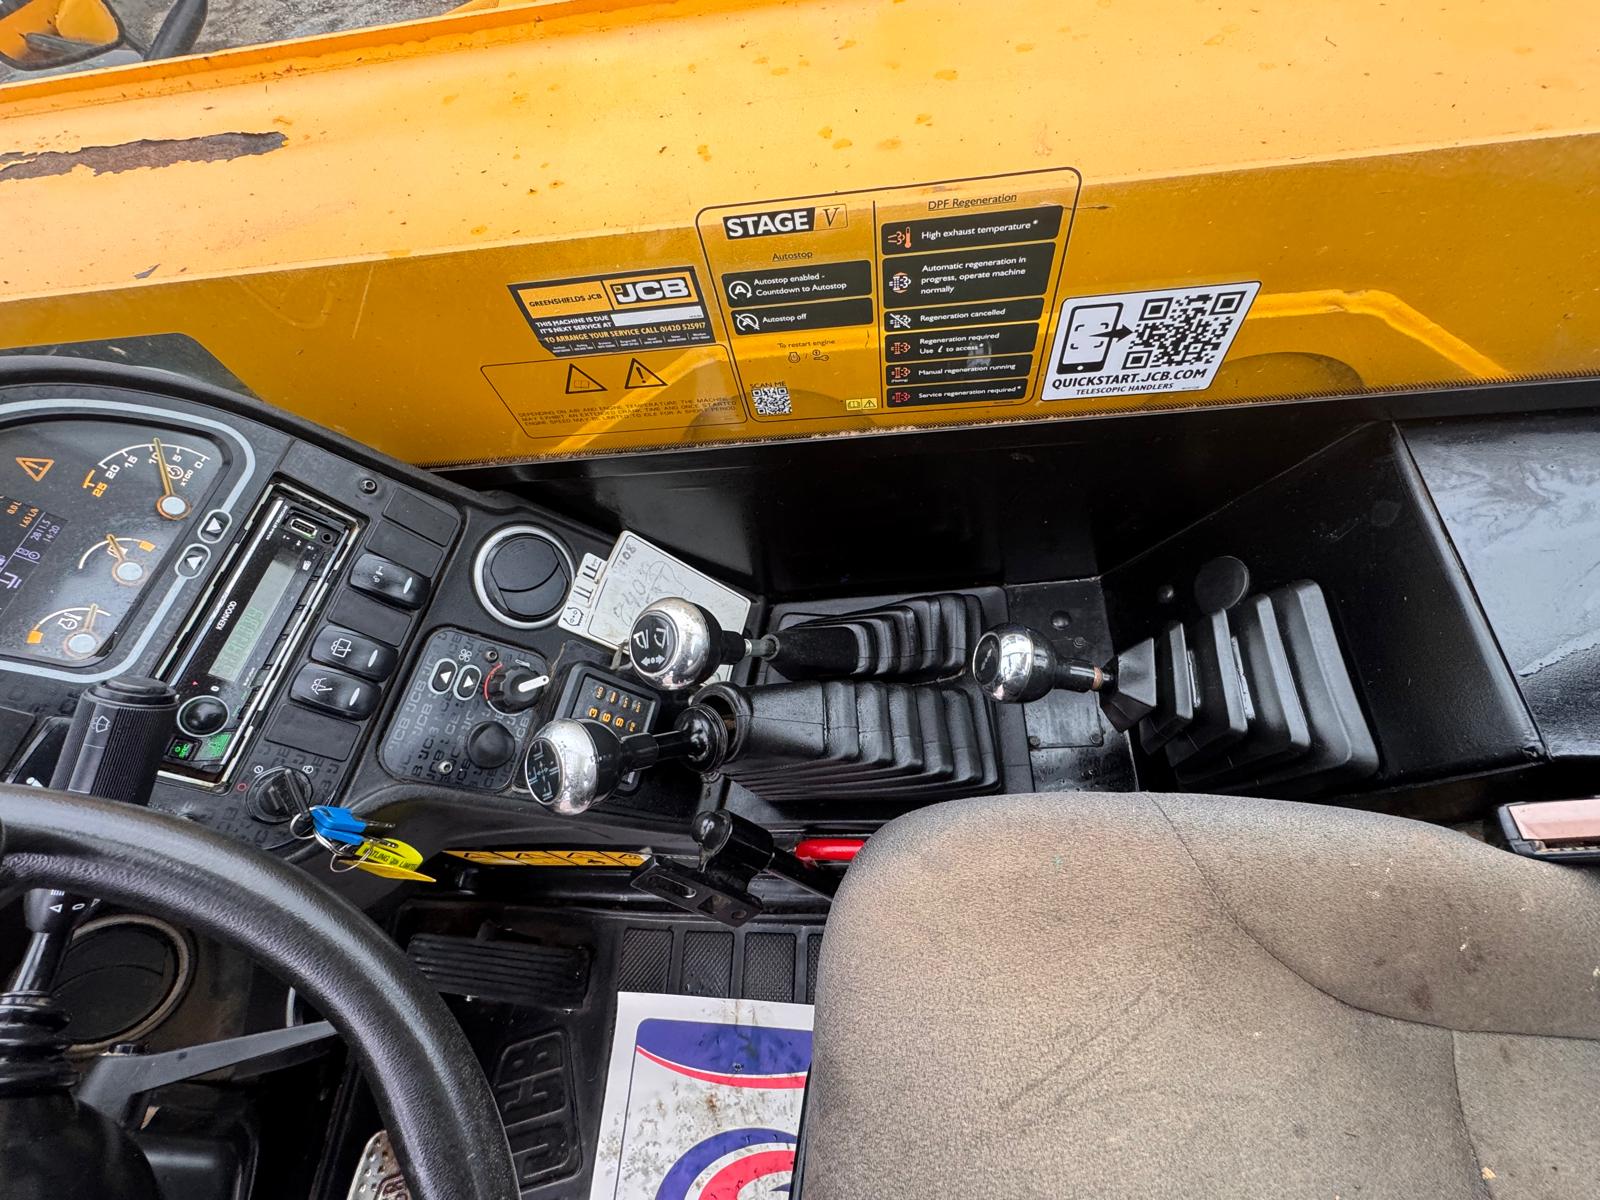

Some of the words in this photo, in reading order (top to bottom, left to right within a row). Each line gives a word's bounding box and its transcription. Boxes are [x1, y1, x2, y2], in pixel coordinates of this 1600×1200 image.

[928, 199, 949, 210] DPF
[952, 193, 1017, 208] Regeneration
[726, 210, 809, 238] STAGE
[823, 207, 840, 227] V
[921, 231, 941, 241] High
[943, 227, 975, 238] exhaust
[977, 221, 1031, 235] temperature
[772, 250, 813, 262] Autostop
[921, 262, 964, 273] Automatic
[965, 256, 1016, 270] regeneration
[1018, 256, 1026, 264] in
[754, 275, 788, 287] Autostop
[790, 273, 819, 283] enabled
[921, 275, 957, 286] progress,
[959, 271, 991, 282] operate
[992, 267, 1026, 277] machine
[615, 278, 690, 304] JCB
[756, 286, 800, 297] Countdown
[802, 285, 810, 293] to
[812, 282, 847, 293] Autostop
[921, 285, 955, 296] normally
[529, 295, 585, 308] GREENSHIELDS
[587, 293, 602, 301] JCB
[535, 320, 552, 328] THIS
[553, 317, 585, 327] MACHINE
[586, 315, 593, 323] IS
[594, 314, 609, 322] DUE
[763, 314, 796, 325] Autostop
[797, 313, 807, 322] off
[920, 311, 969, 323] Regeneration
[971, 308, 1006, 319] cancelled
[544, 336, 555, 344] TO
[557, 333, 589, 343] ARRANGE
[589, 331, 609, 339] YOUR
[610, 328, 640, 337] SERVICE
[641, 326, 659, 335] CALL
[660, 324, 681, 333] 01420
[682, 322, 706, 331] 525917
[574, 323, 602, 331] SERVICE
[920, 335, 967, 346] Regeneration
[968, 332, 1000, 342] required
[919, 347, 933, 355] Use
[918, 368, 943, 376] Manual
[944, 365, 988, 375] regeneration
[989, 363, 1016, 373] running
[750, 381, 773, 389] SCAN
[774, 380, 786, 388] ME
[1052, 368, 1208, 390] QUICKSTART.JCB.COM
[918, 391, 943, 399] Service
[944, 389, 986, 398] regeneration
[1076, 385, 1126, 396] TELESCOPIC
[1128, 382, 1174, 393] HANDLERS
[124, 455, 138, 468] 15
[148, 451, 160, 464] 10
[172, 455, 182, 463] 5
[105, 464, 120, 480] 20
[194, 461, 204, 469] 0
[180, 469, 194, 487] x100
[92, 481, 108, 498] 25
[216, 600, 237, 631] KENWOOD
[588, 708, 598, 718] 3
[602, 712, 611, 722] 6
[616, 717, 624, 728] 9
